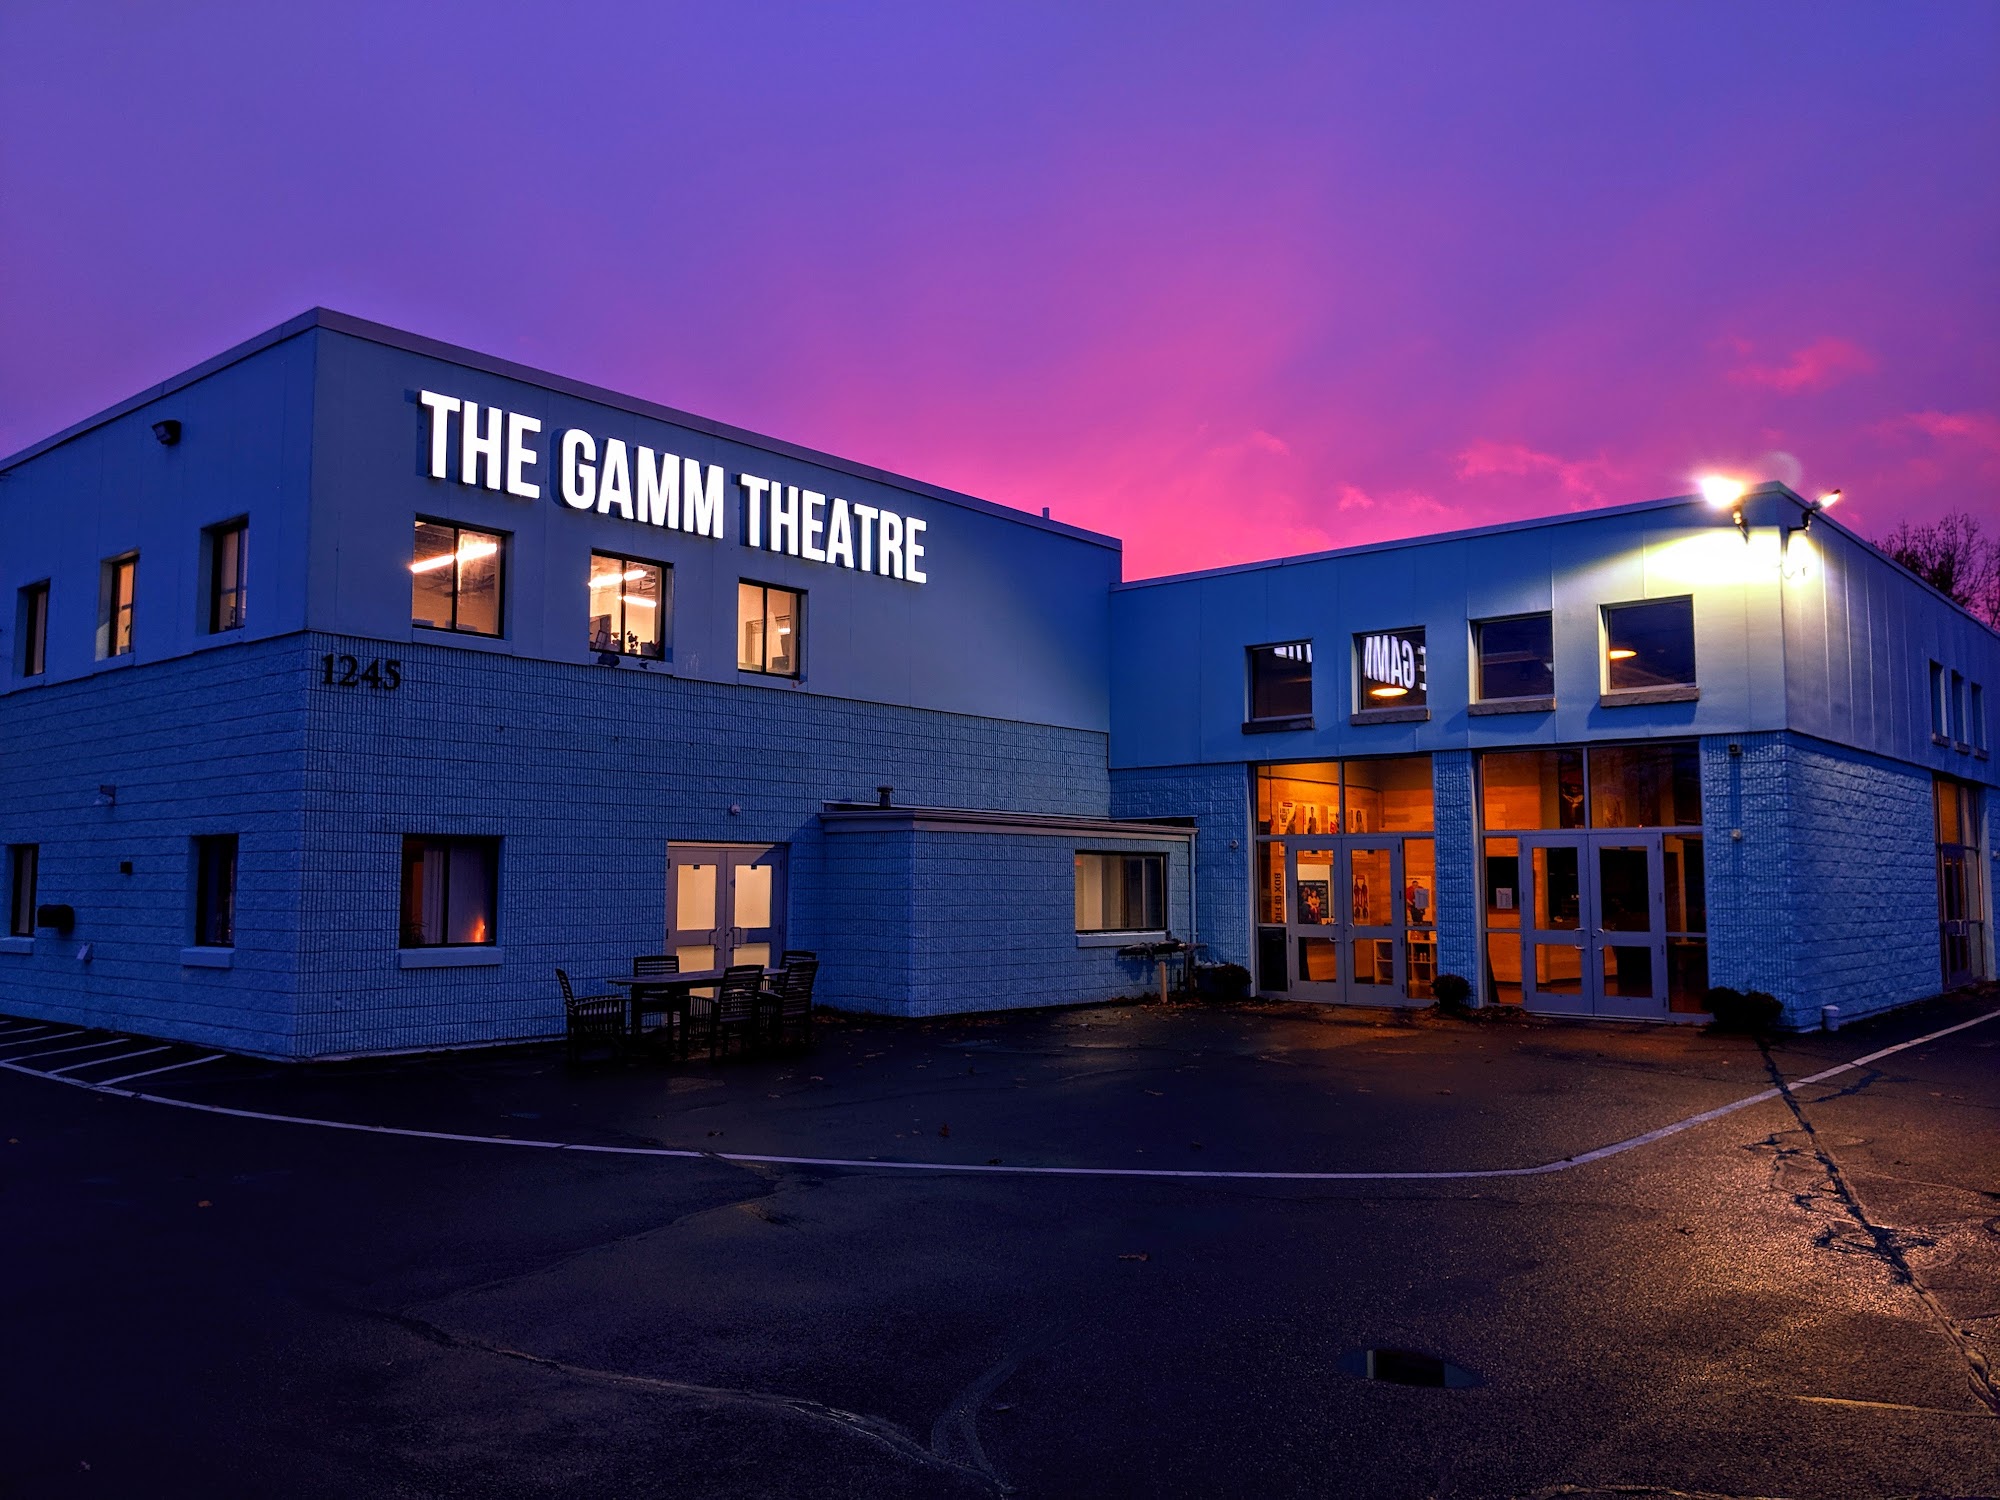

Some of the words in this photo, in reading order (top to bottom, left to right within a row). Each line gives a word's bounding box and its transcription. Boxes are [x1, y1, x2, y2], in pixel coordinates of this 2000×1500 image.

[420, 390, 542, 499] THE
[560, 428, 725, 539] GAMM
[739, 472, 928, 584] THEATRE
[321, 653, 401, 690] 1245
[1274, 873, 1282, 893] BOX
[1274, 896, 1283, 923] OFFIC
